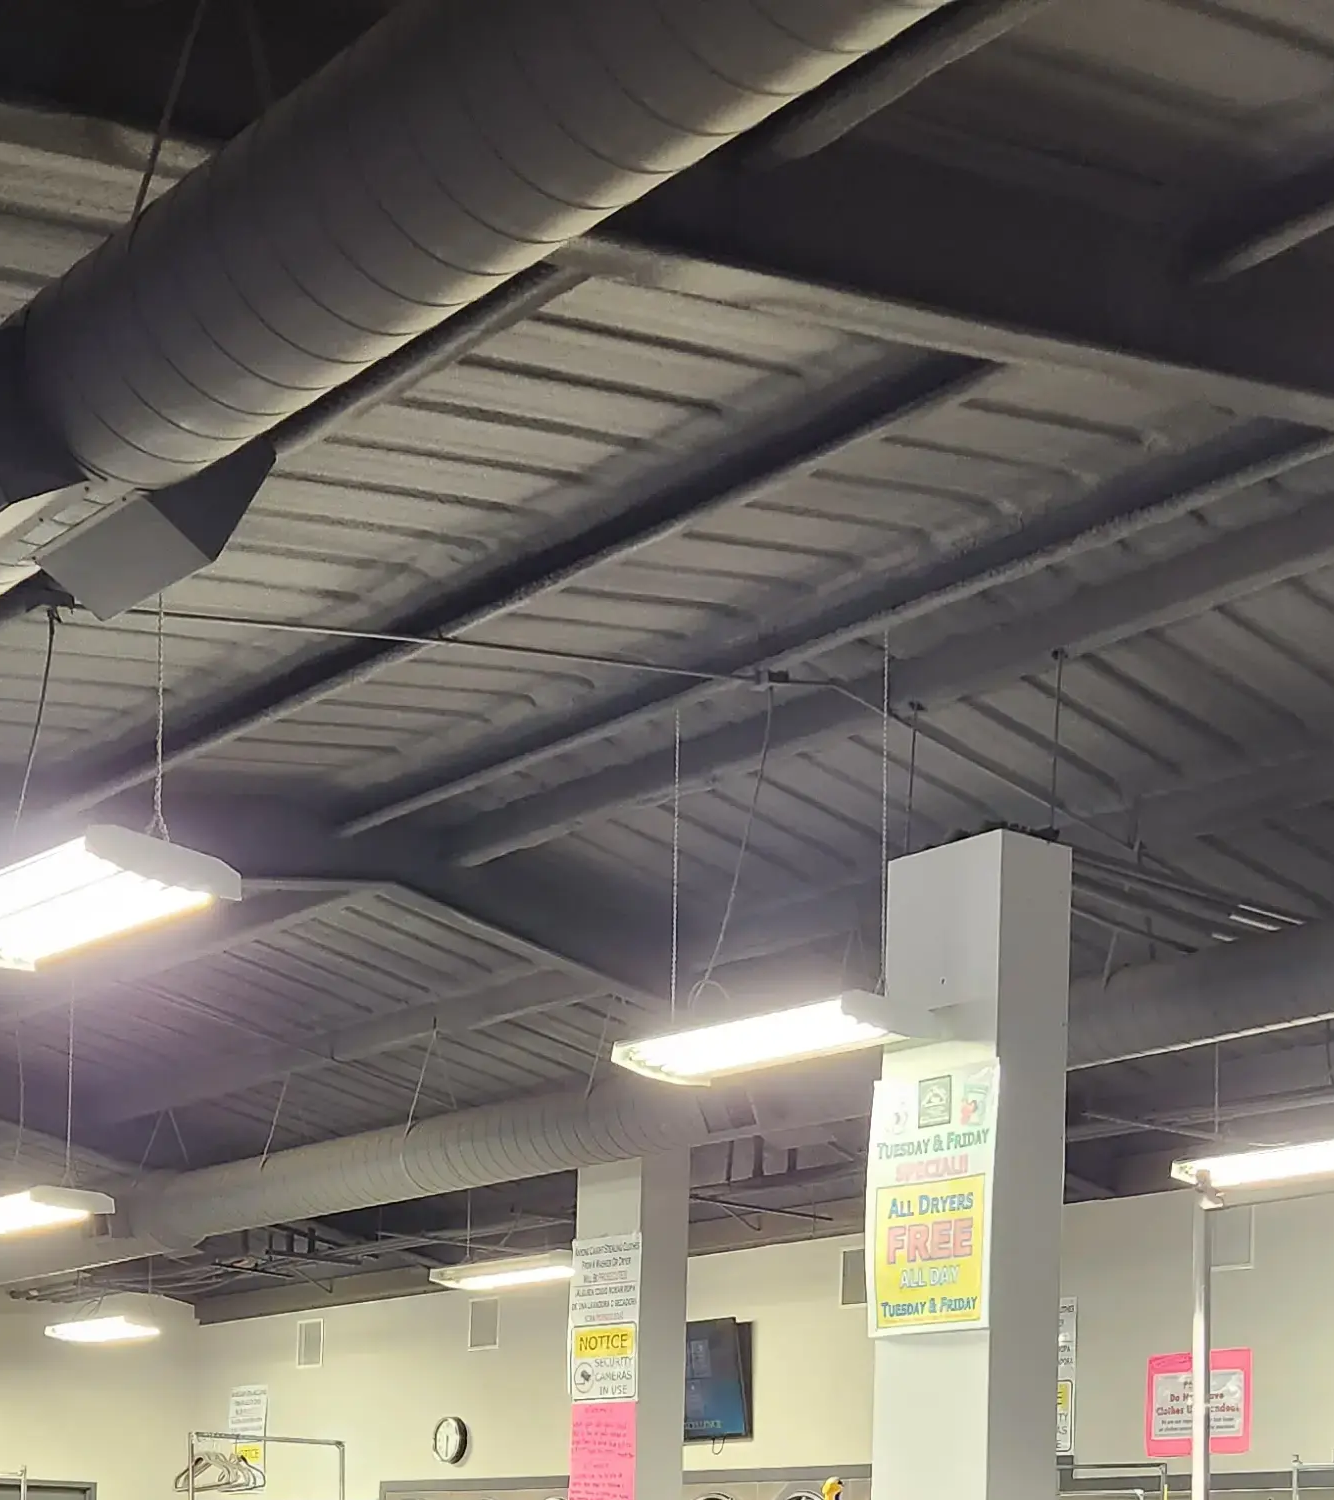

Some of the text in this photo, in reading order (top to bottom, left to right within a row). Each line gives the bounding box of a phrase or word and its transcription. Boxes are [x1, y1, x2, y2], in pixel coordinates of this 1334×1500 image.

[876, 1128, 990, 1160] TUESDAY & FRIDAY
[888, 1192, 974, 1219] ALL DRYERS
[887, 1217, 973, 1265] FREE
[900, 1264, 960, 1289] ALL DAY
[881, 1301, 927, 1318] TUESDAY
[929, 1297, 937, 1313] &
[939, 1296, 978, 1313] FRIDAY
[579, 1333, 628, 1351] NOTICE
[594, 1356, 633, 1368] SECURITY
[594, 1369, 633, 1382] CAMERAS
[599, 1384, 628, 1395] IN USE
